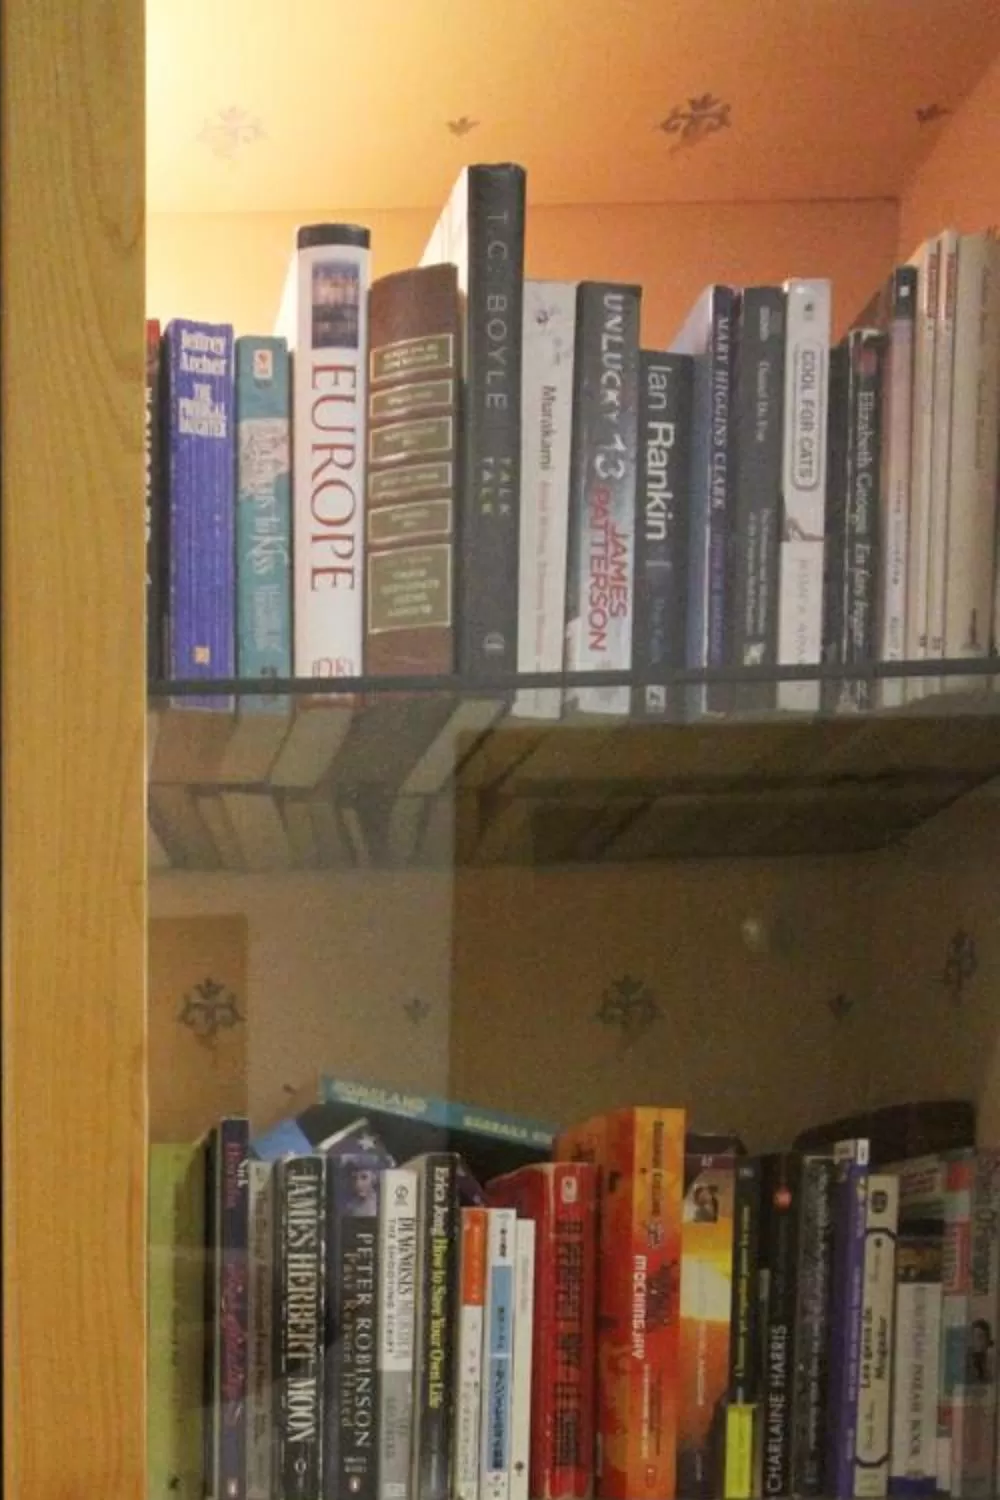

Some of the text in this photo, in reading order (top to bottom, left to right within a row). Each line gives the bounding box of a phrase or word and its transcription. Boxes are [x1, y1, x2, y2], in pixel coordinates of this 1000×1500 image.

[484, 294, 510, 411] BOYLE
[594, 292, 628, 482] UNLUCKY 13
[540, 384, 559, 471] Murakami
[645, 364, 675, 542] Ian Rankin
[713, 369, 729, 447] HIGGINS
[798, 349, 815, 479] COOL FOR CATS
[855, 390, 875, 469] Elizabeth
[310, 363, 356, 593] EUROPE
[711, 452, 728, 511] CLARK
[587, 486, 612, 652] PATTERSON
[607, 524, 629, 619] JAMES
[430, 1204, 449, 1237] Jong
[433, 1165, 450, 1204] Erica
[397, 1216, 417, 1296] DIAGNOSIS
[432, 1236, 448, 1268] How
[286, 1172, 318, 1445] JAMES HERBERT MOON
[354, 1232, 374, 1448] PETER ROBINSON
[431, 1288, 447, 1317] Save
[429, 1348, 445, 1381] Own
[766, 1323, 788, 1494] CHARLAINE HARRIS
